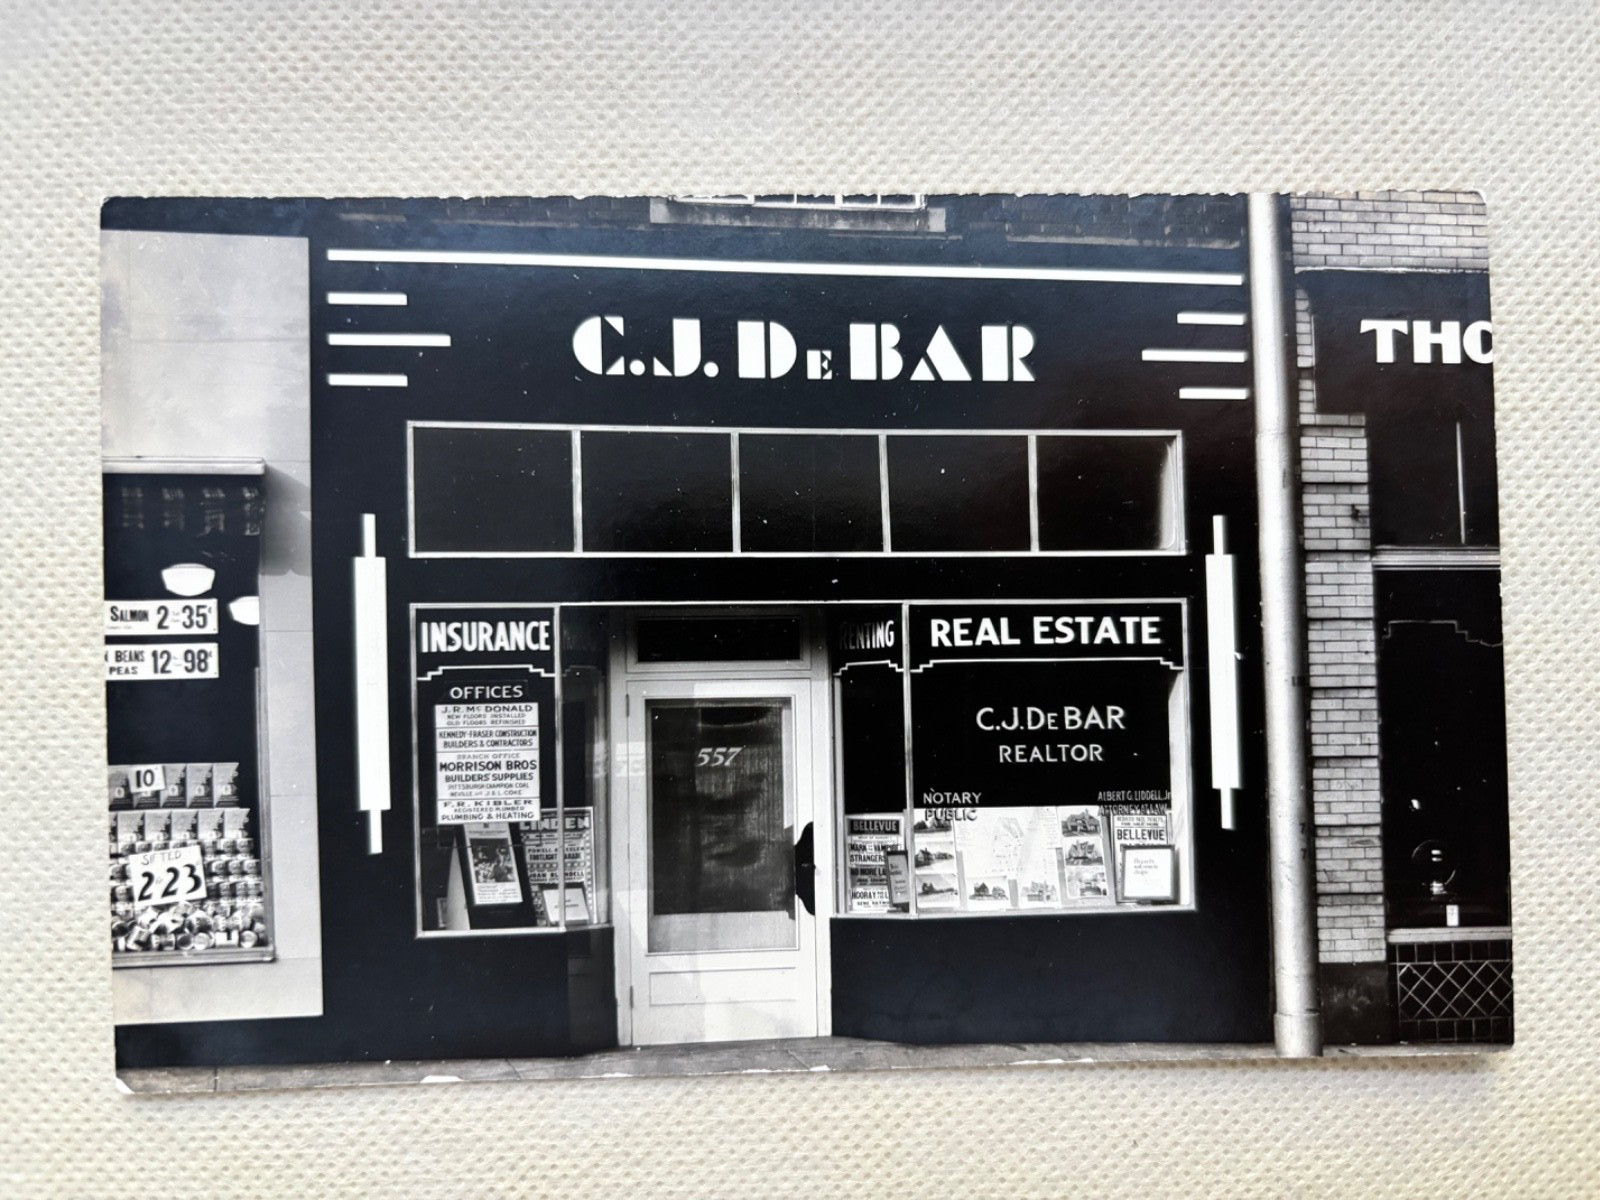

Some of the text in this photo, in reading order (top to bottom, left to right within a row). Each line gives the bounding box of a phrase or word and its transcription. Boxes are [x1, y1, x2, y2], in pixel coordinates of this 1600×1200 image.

[572, 316, 719, 378] C.J.
[849, 323, 1036, 382] BAR
[110, 605, 149, 622] SALMON
[157, 605, 170, 630] 2
[421, 621, 551, 653] INSURANCE
[840, 620, 895, 650] RENTING
[930, 616, 1162, 648] REAL ESTATE
[115, 650, 145, 663] BEANS
[151, 650, 172, 674] 12
[109, 666, 138, 675] PEAS
[450, 685, 523, 699] OFFICES
[1064, 706, 1126, 730] BAR
[495, 729, 538, 737] CONSTRUCTION
[443, 739, 533, 748] BUILDERS & CONTRACTORS
[696, 747, 743, 767] 557
[999, 744, 1105, 763] REALTOR
[439, 759, 538, 772] MORRISON BROS
[491, 772, 534, 782] SUPPLIES
[923, 792, 982, 805] NOTARY
[1097, 790, 1126, 801] ALBERT
[441, 813, 484, 821] PLUMBING
[496, 811, 535, 819] HEATING
[925, 808, 978, 822] PUBLIC
[853, 820, 897, 832] BELLEVUE
[1116, 828, 1165, 841] BELLEVUE
